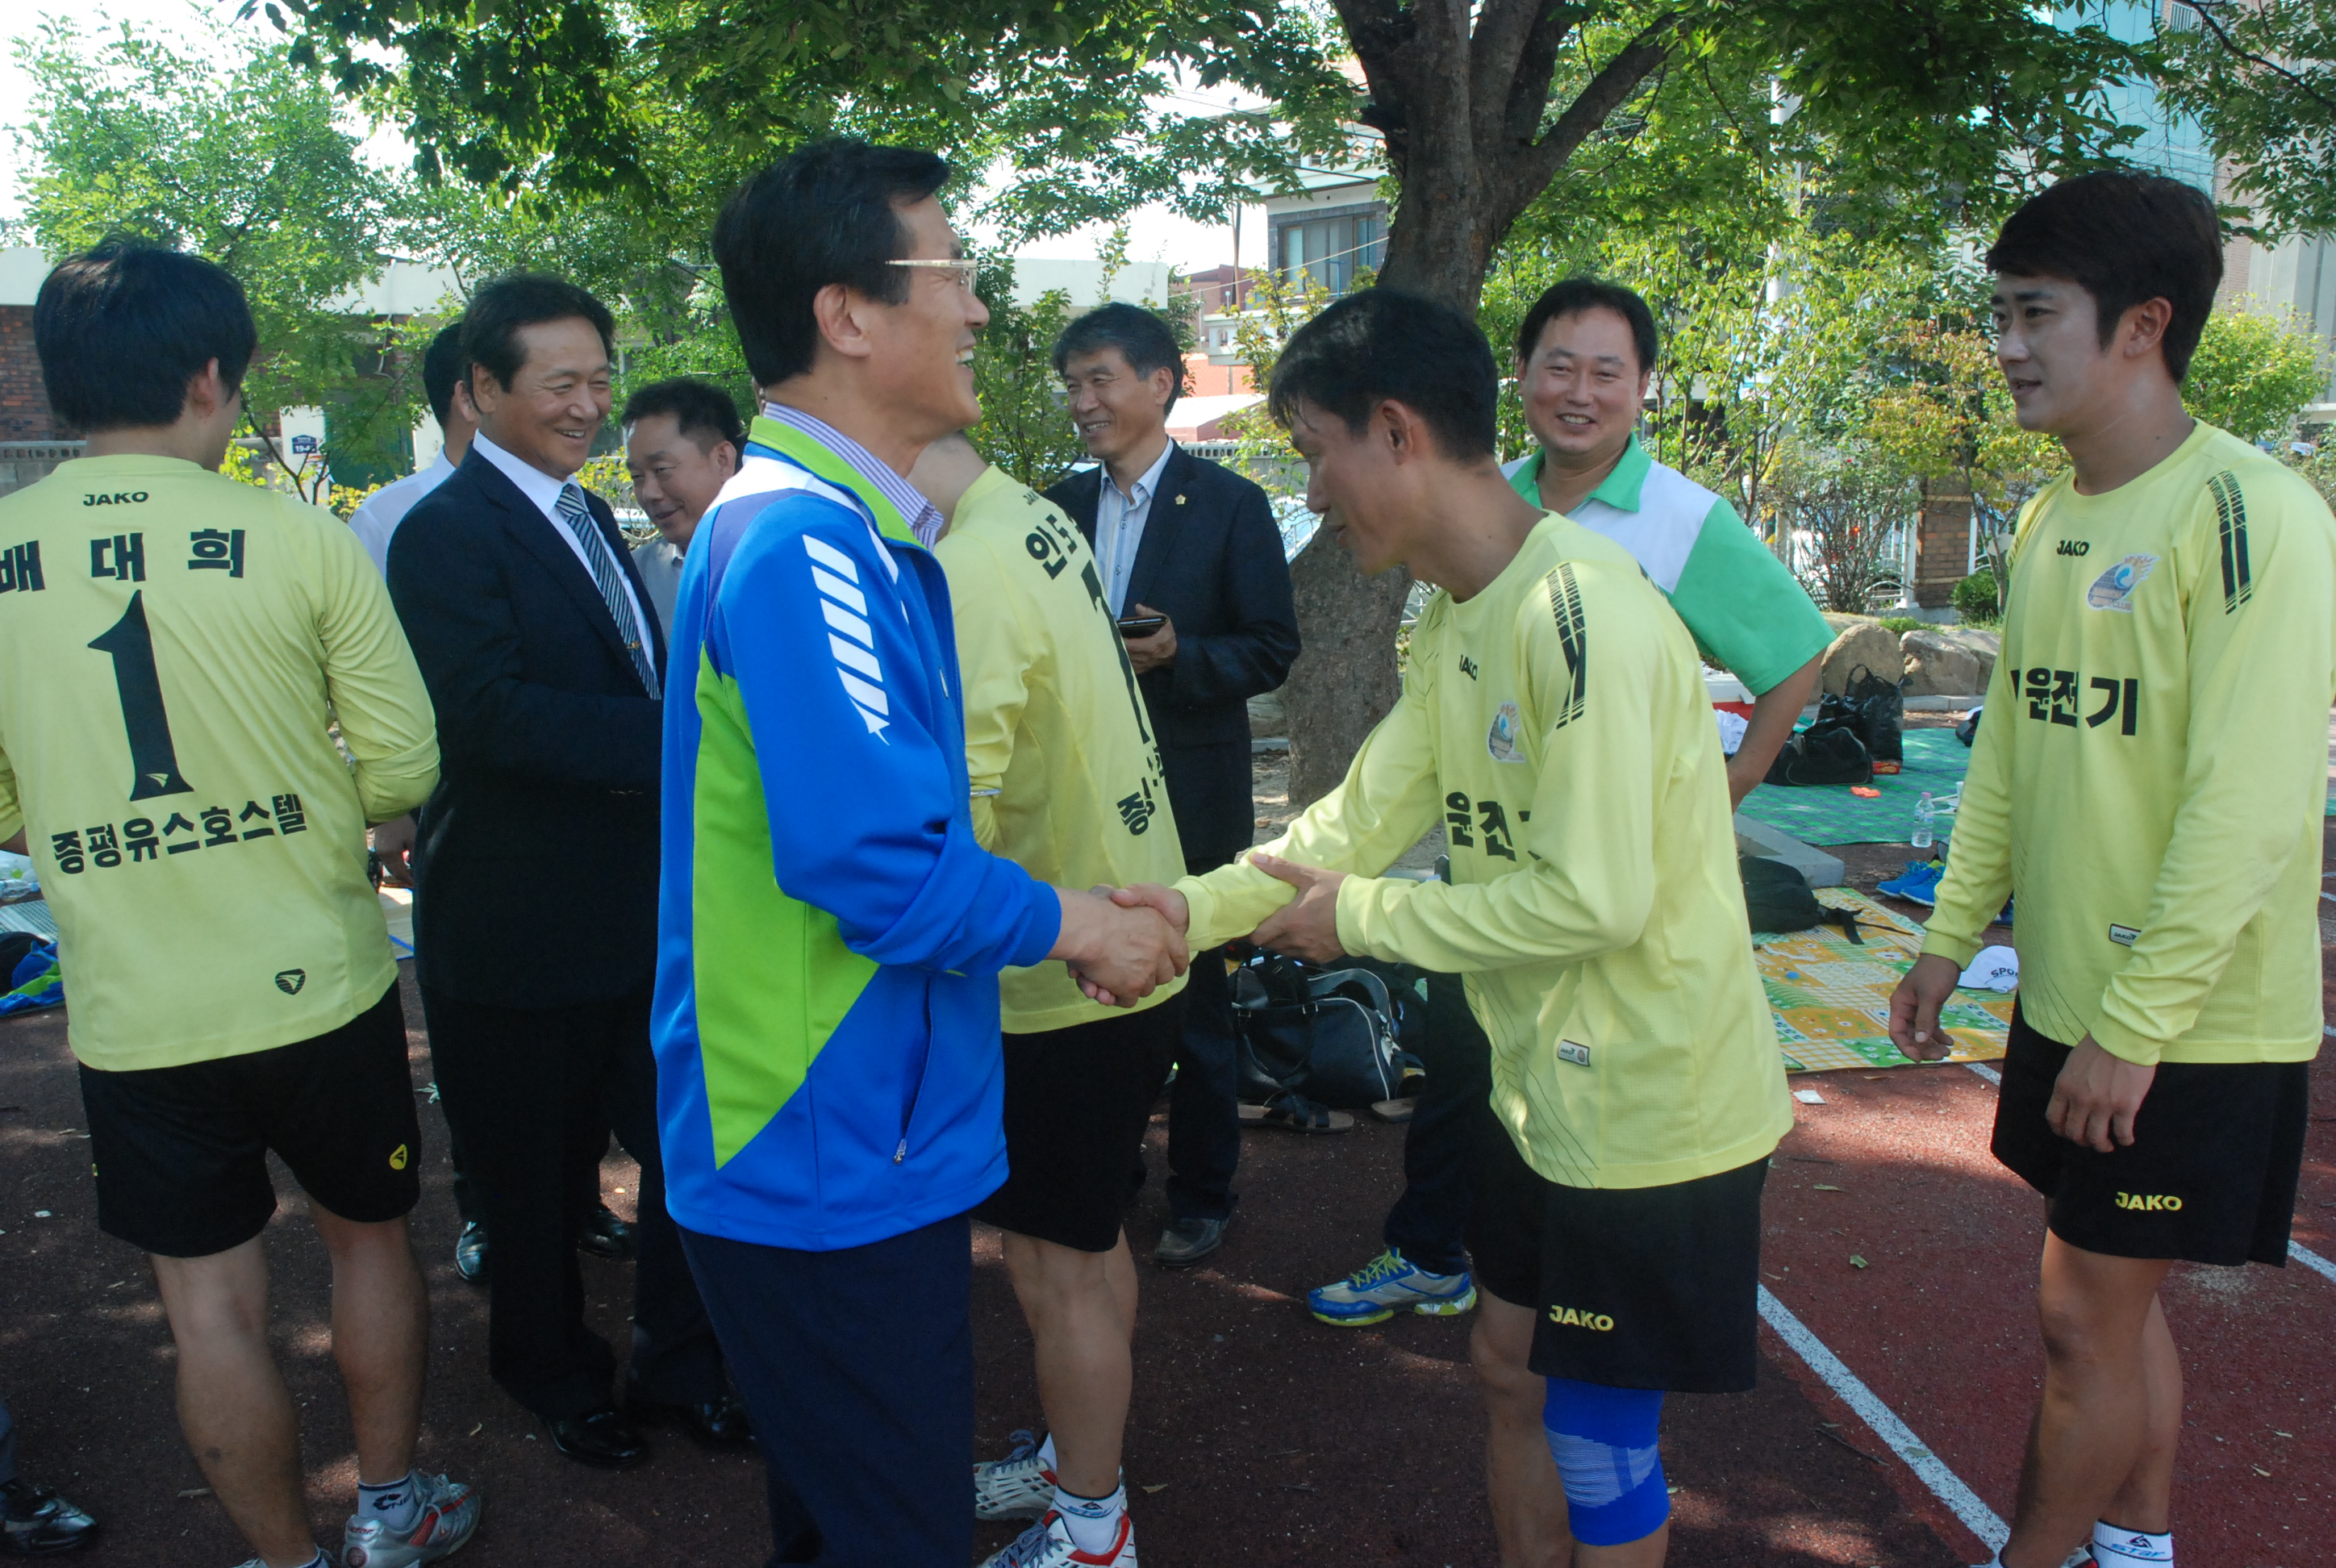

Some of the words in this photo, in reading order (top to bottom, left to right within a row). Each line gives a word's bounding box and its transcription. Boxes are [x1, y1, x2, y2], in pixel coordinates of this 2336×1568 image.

[83, 491, 149, 507] JAKO
[2057, 540, 2090, 557] JAKO
[87, 589, 194, 802] 1
[51, 794, 307, 874] 증평유스호스텔
[2115, 1191, 2182, 1211] JAKO
[1549, 1304, 1614, 1331] JAKO
